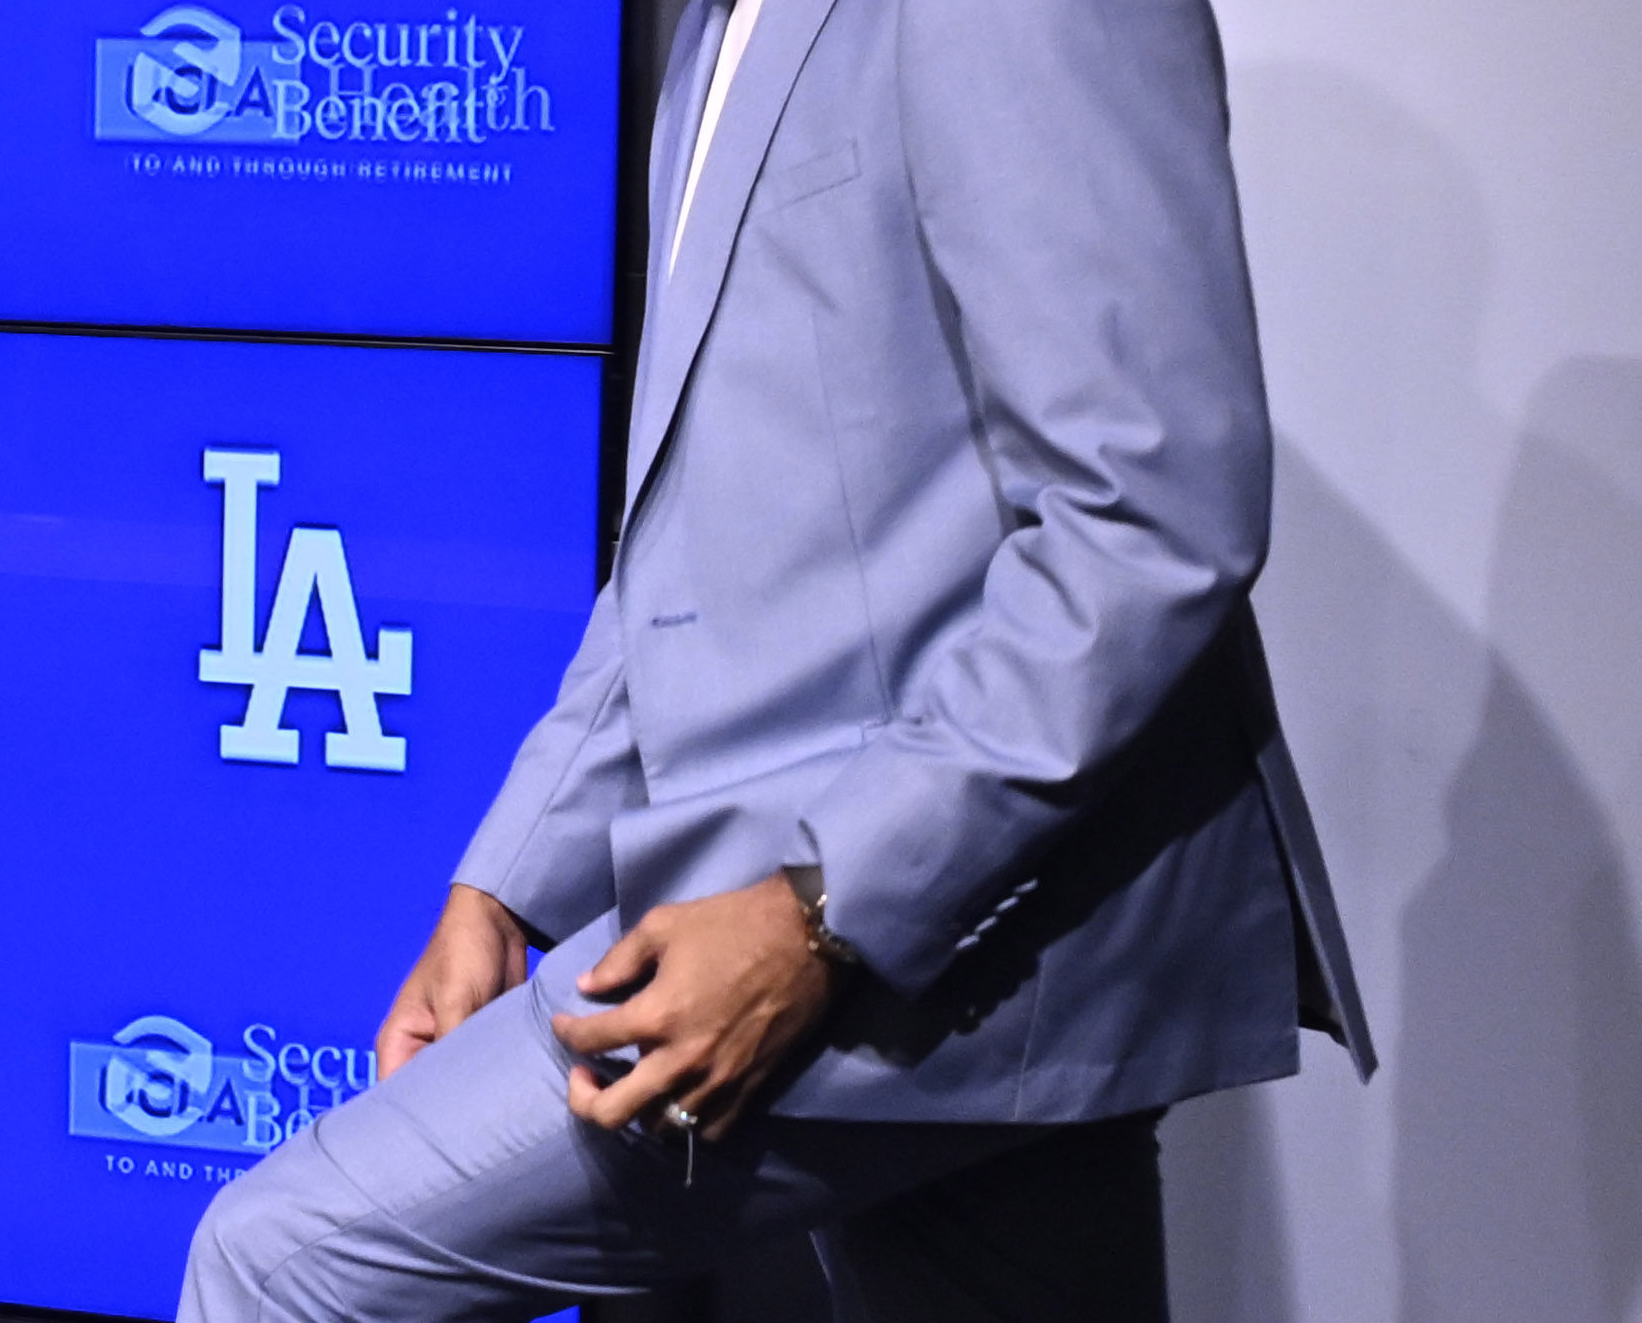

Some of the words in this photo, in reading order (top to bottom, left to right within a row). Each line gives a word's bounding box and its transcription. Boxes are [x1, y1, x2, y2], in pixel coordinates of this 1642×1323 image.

[271, 8, 523, 79] Security
[272, 78, 489, 144] Benefit
[198, 449, 413, 772] LA
[242, 1023, 377, 1089] Secu
[106, 1155, 135, 1174] TO
[145, 1159, 193, 1180] AND
